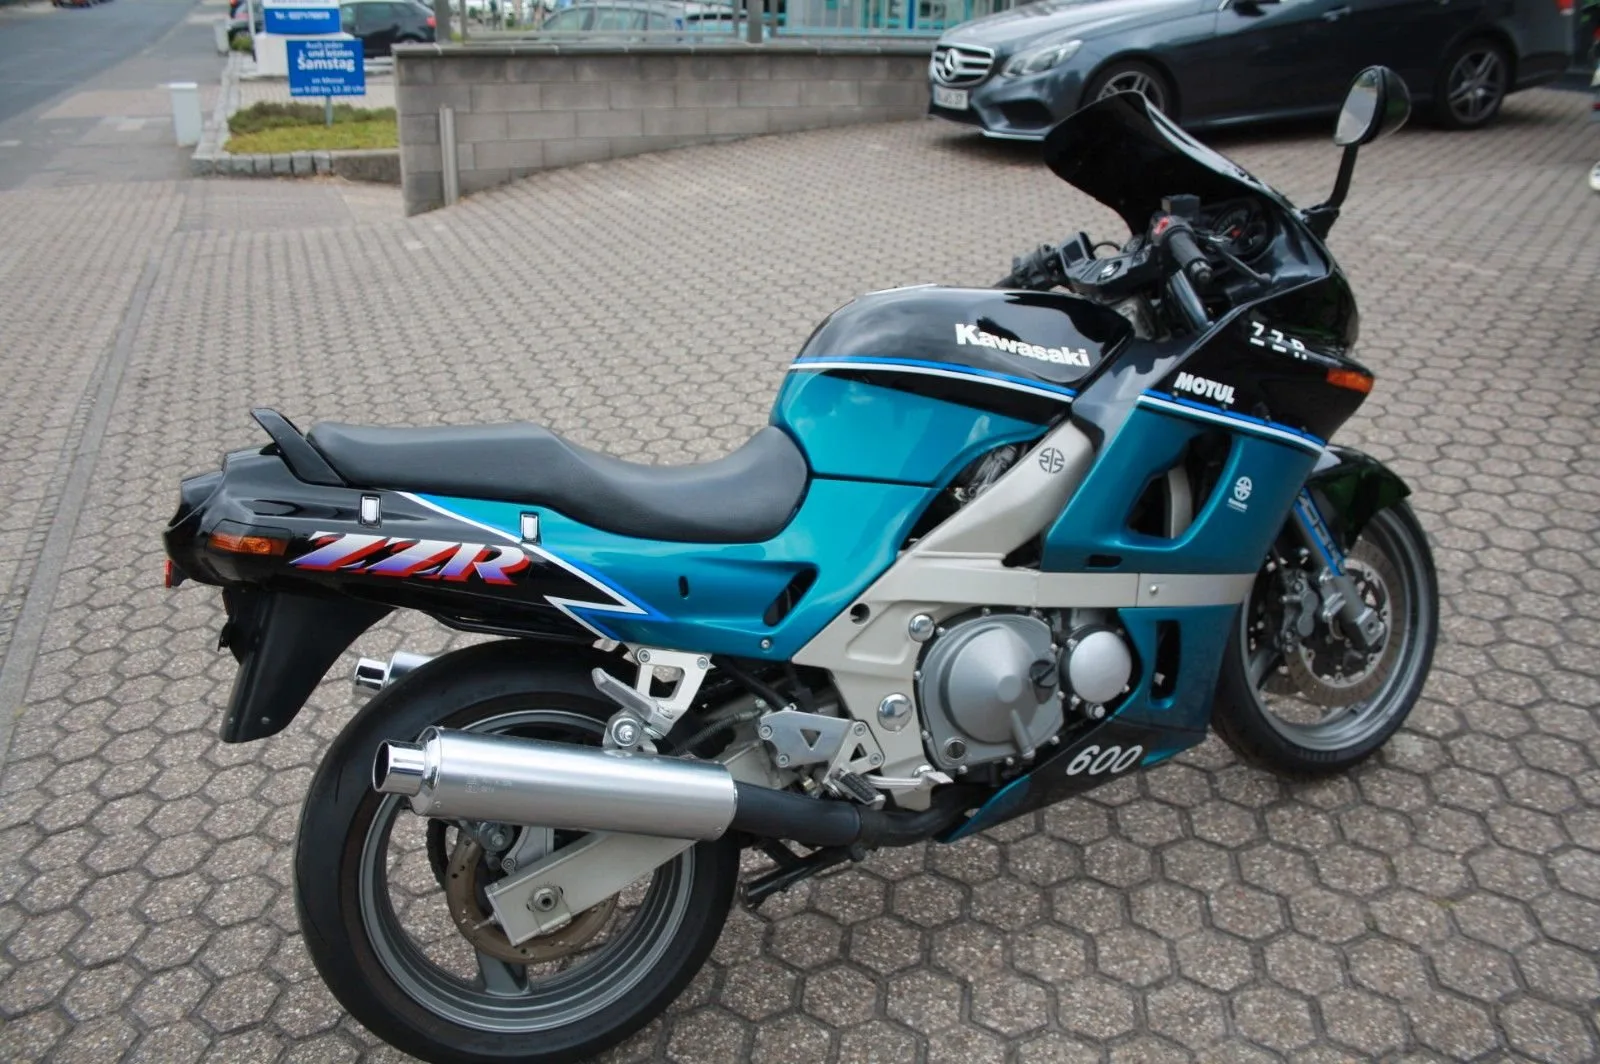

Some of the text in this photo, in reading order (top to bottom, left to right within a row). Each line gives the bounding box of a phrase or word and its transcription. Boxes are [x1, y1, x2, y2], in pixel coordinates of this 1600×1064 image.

[297, 57, 355, 72] Samstag
[308, 49, 325, 58] und
[955, 323, 1091, 367] Kawasaki
[1174, 371, 1235, 404] MOTUL
[289, 530, 530, 586] ZZR
[1066, 744, 1143, 775] 600
